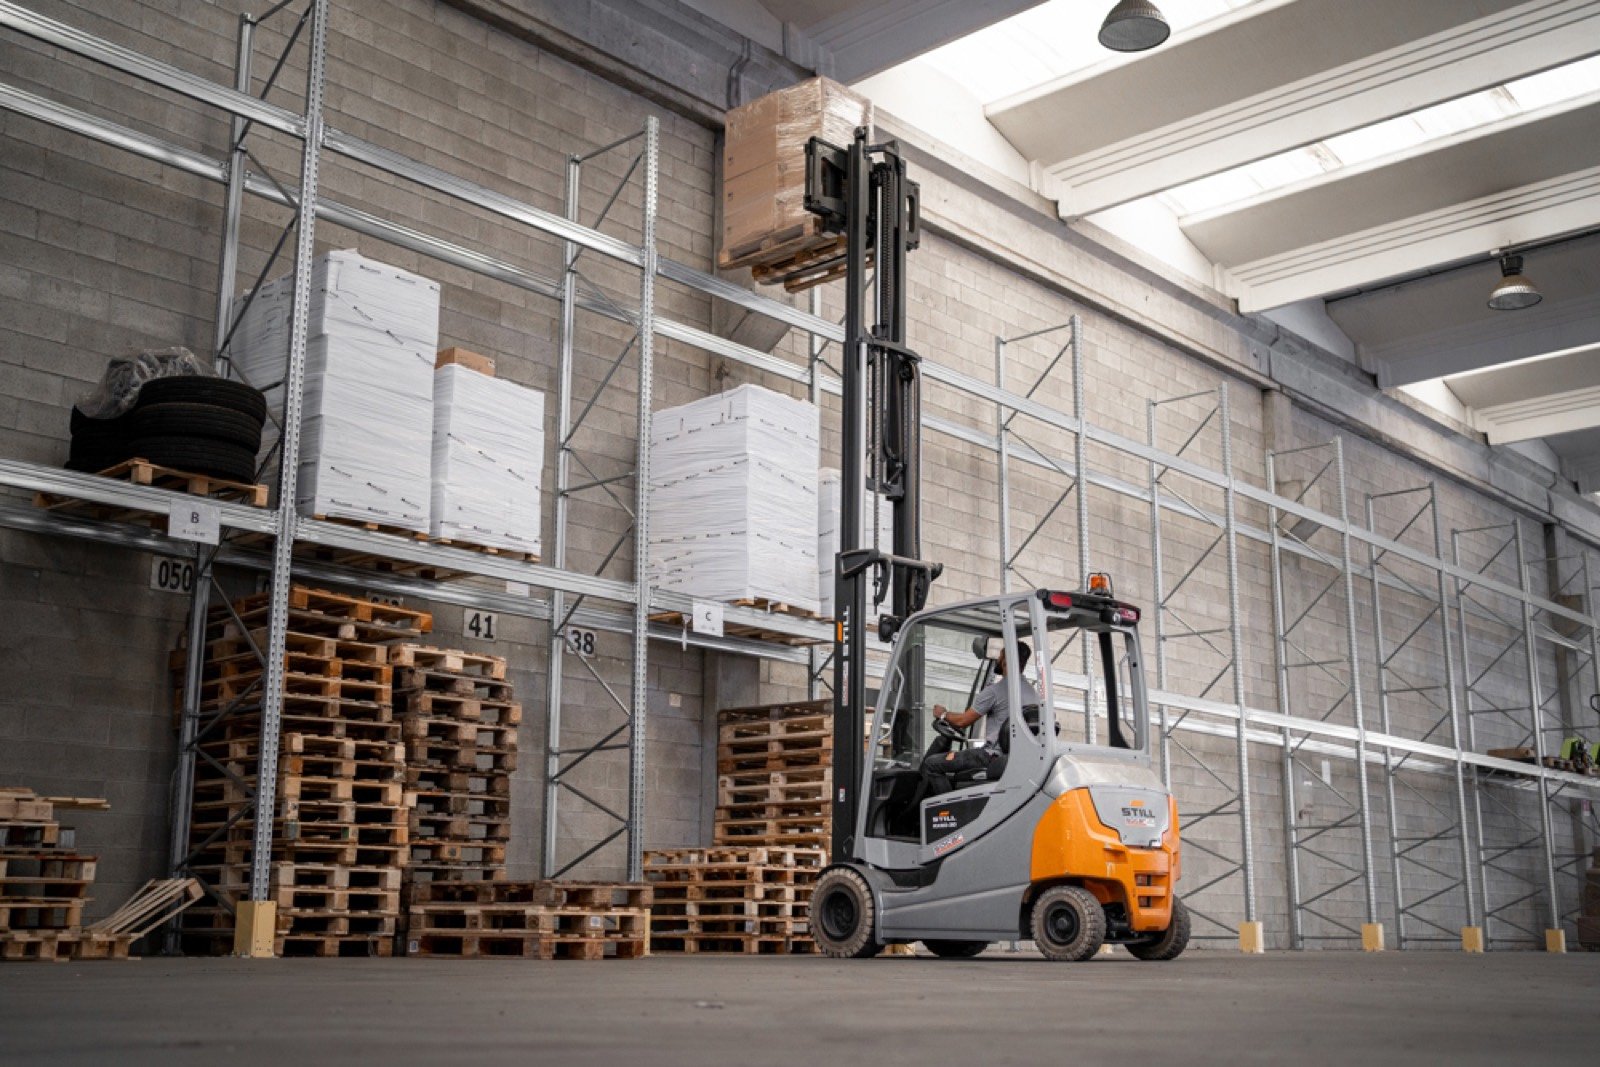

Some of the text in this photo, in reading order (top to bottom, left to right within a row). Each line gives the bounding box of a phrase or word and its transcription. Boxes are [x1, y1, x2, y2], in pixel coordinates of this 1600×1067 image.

[191, 511, 200, 524] B
[158, 560, 193, 592] 050
[468, 612, 494, 639] 41
[705, 611, 712, 621] C
[571, 629, 594, 655] 38
[842, 604, 850, 657] STILL
[1121, 807, 1155, 818] STILL
